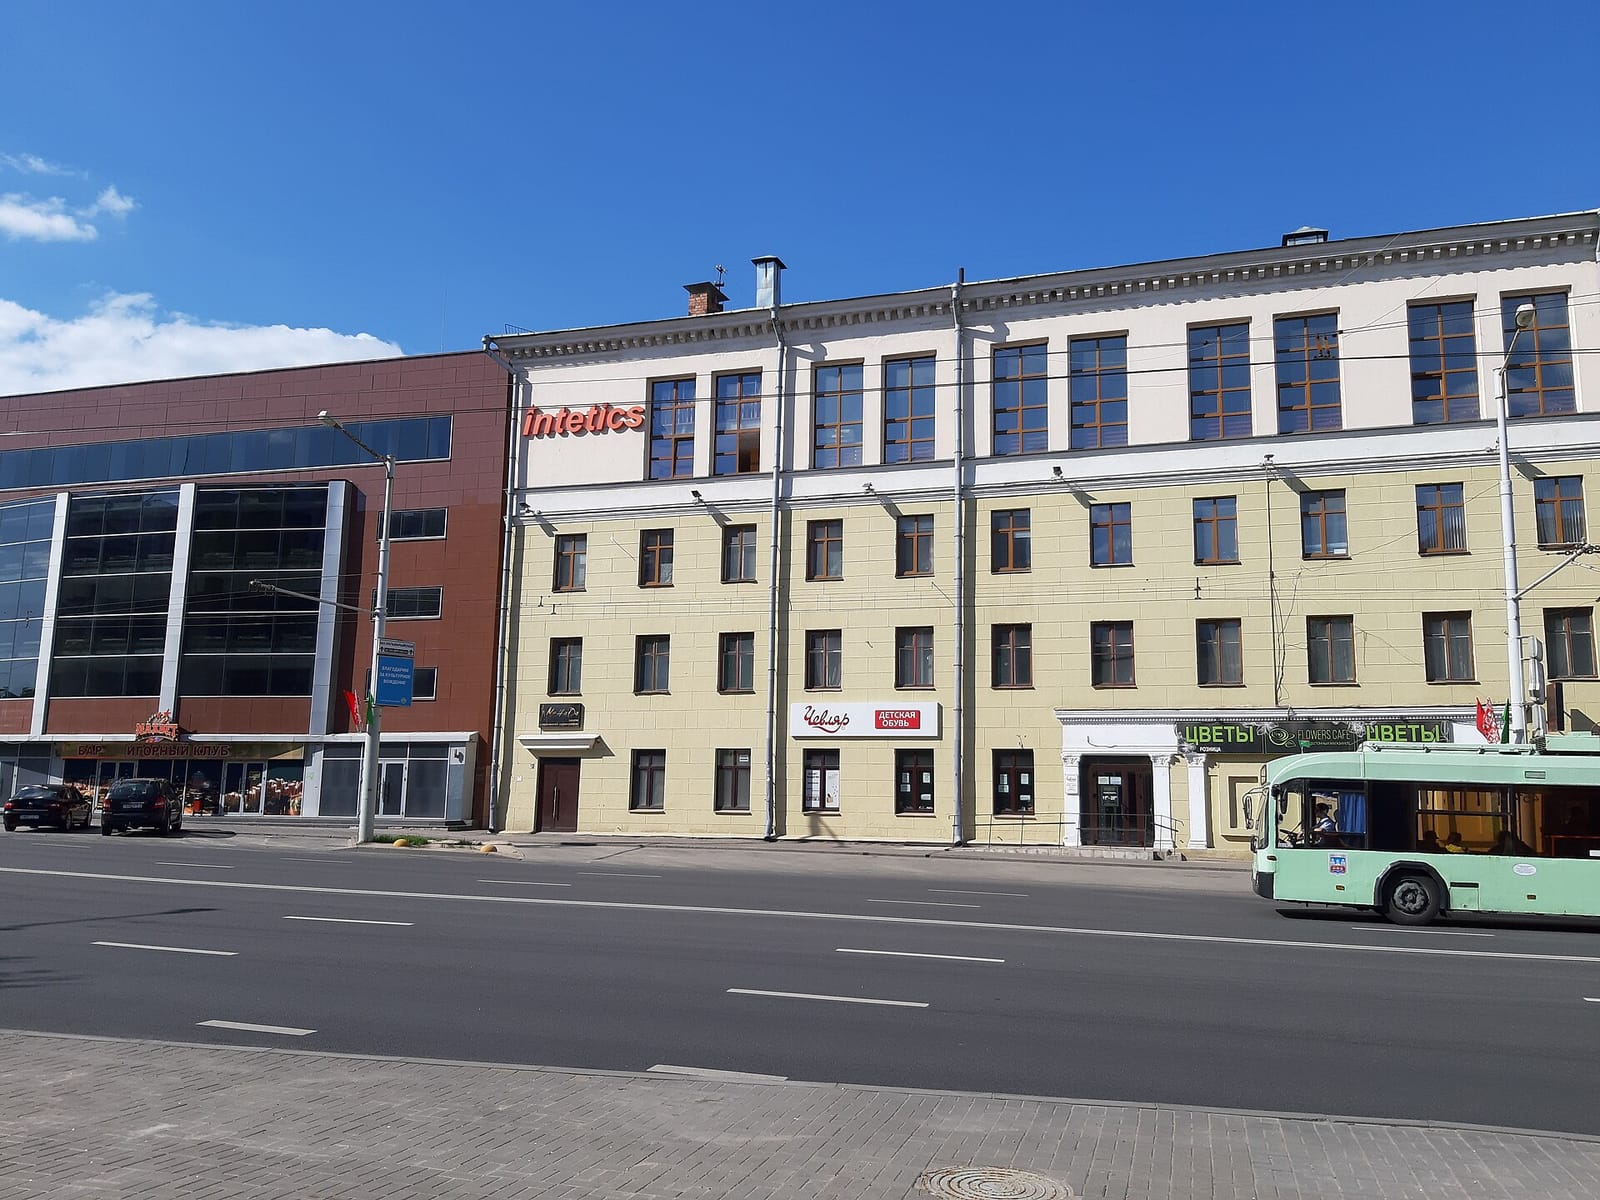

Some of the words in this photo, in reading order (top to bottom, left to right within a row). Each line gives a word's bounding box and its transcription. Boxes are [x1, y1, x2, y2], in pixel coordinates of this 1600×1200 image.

[522, 403, 644, 436] intetics
[803, 705, 850, 733] Чевляр
[879, 711, 916, 720] ДЕТСКАЯ
[882, 719, 910, 727] ОБУВЬ
[1185, 726, 1254, 745] ЦВЕТЫ
[1297, 729, 1331, 740] FLOWERS
[1366, 725, 1441, 742] ЦВЕТЫ
[78, 745, 102, 756] БАР
[127, 743, 189, 756] ИГОРНЫЙ
[193, 744, 229, 756] КЛУБ
